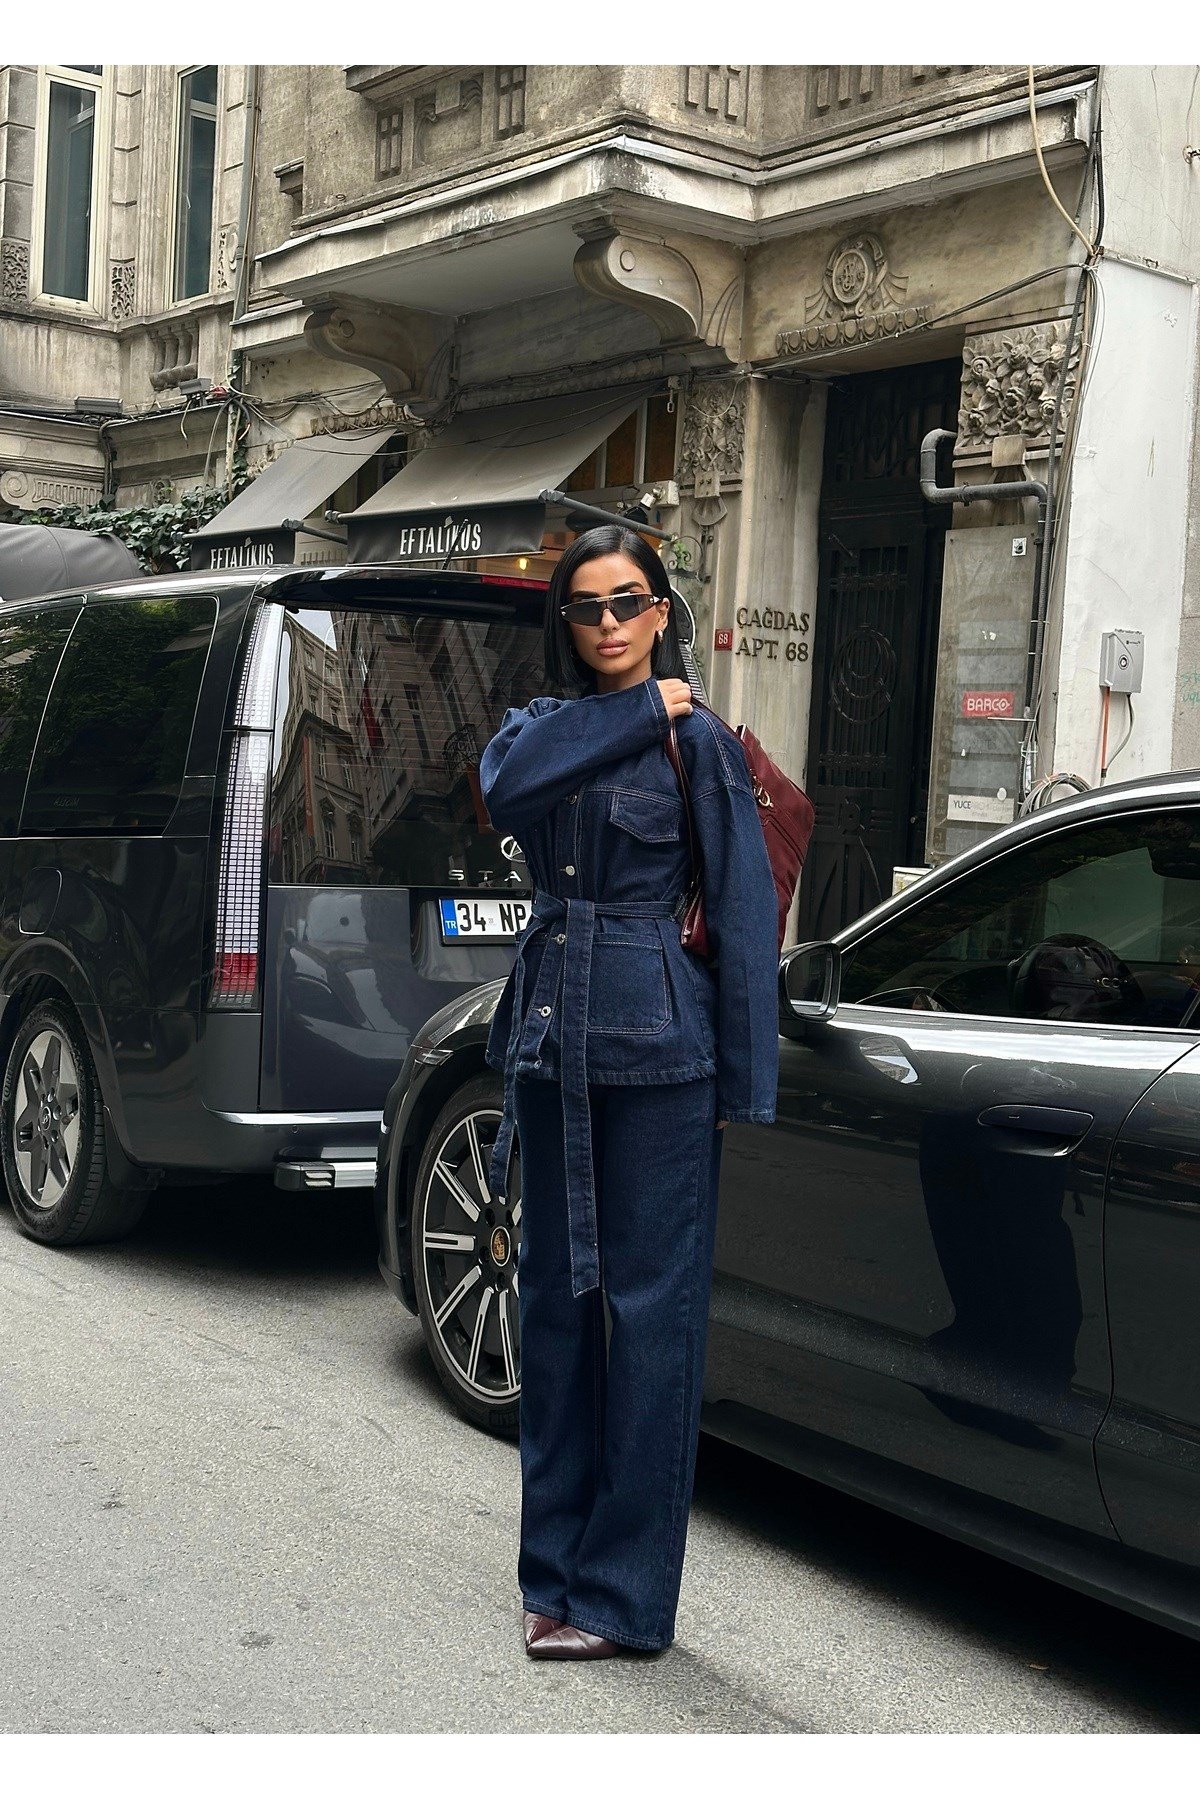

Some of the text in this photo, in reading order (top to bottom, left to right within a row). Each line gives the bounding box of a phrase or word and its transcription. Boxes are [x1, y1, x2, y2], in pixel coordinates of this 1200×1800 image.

[736, 606, 810, 636] ÇAĞDAŞ
[718, 633, 729, 645] 68
[735, 636, 809, 662] APT. 68
[967, 697, 1011, 712] BARCO
[445, 920, 457, 930] TR
[457, 903, 527, 932] 34 NP
